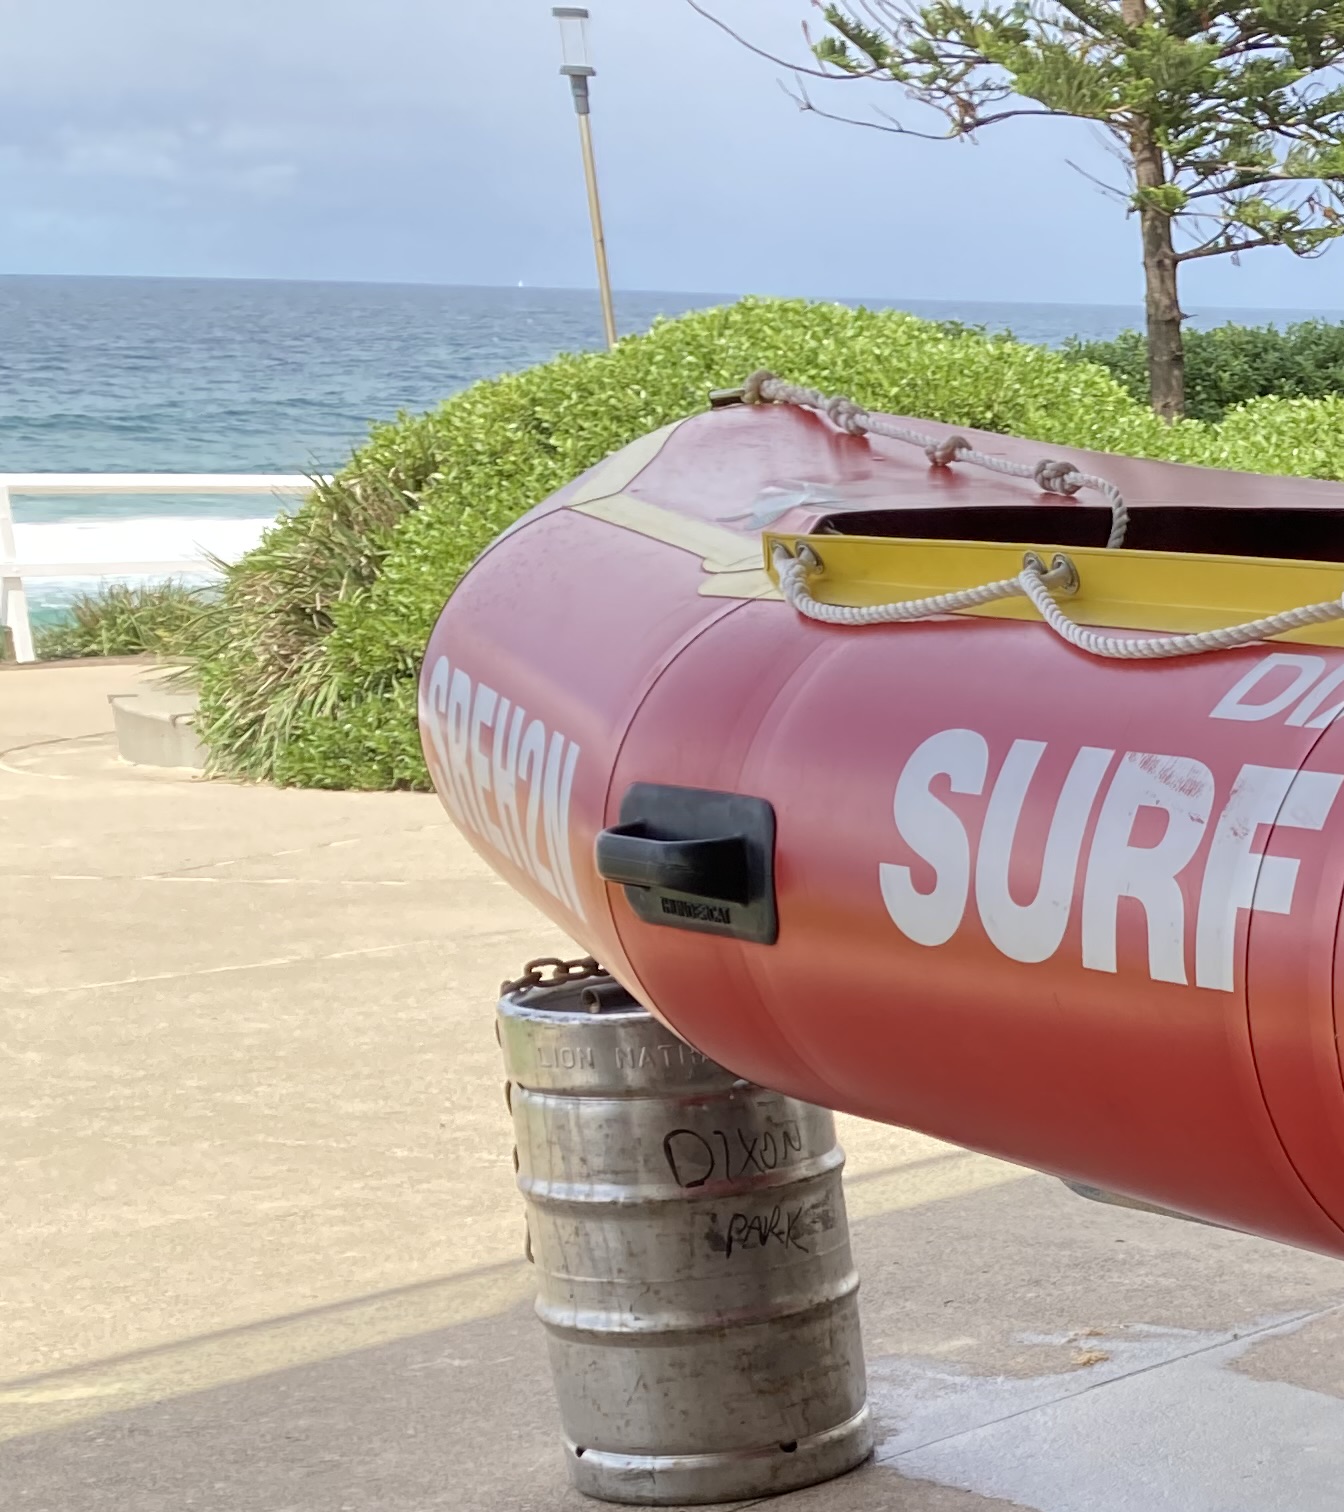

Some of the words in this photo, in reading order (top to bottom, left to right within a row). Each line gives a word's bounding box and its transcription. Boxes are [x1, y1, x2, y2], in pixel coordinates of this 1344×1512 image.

[879, 727, 1344, 992] SURF
[537, 1047, 595, 1070] LION
[663, 1119, 802, 1189] DIXON
[725, 1205, 809, 1259] PARK
